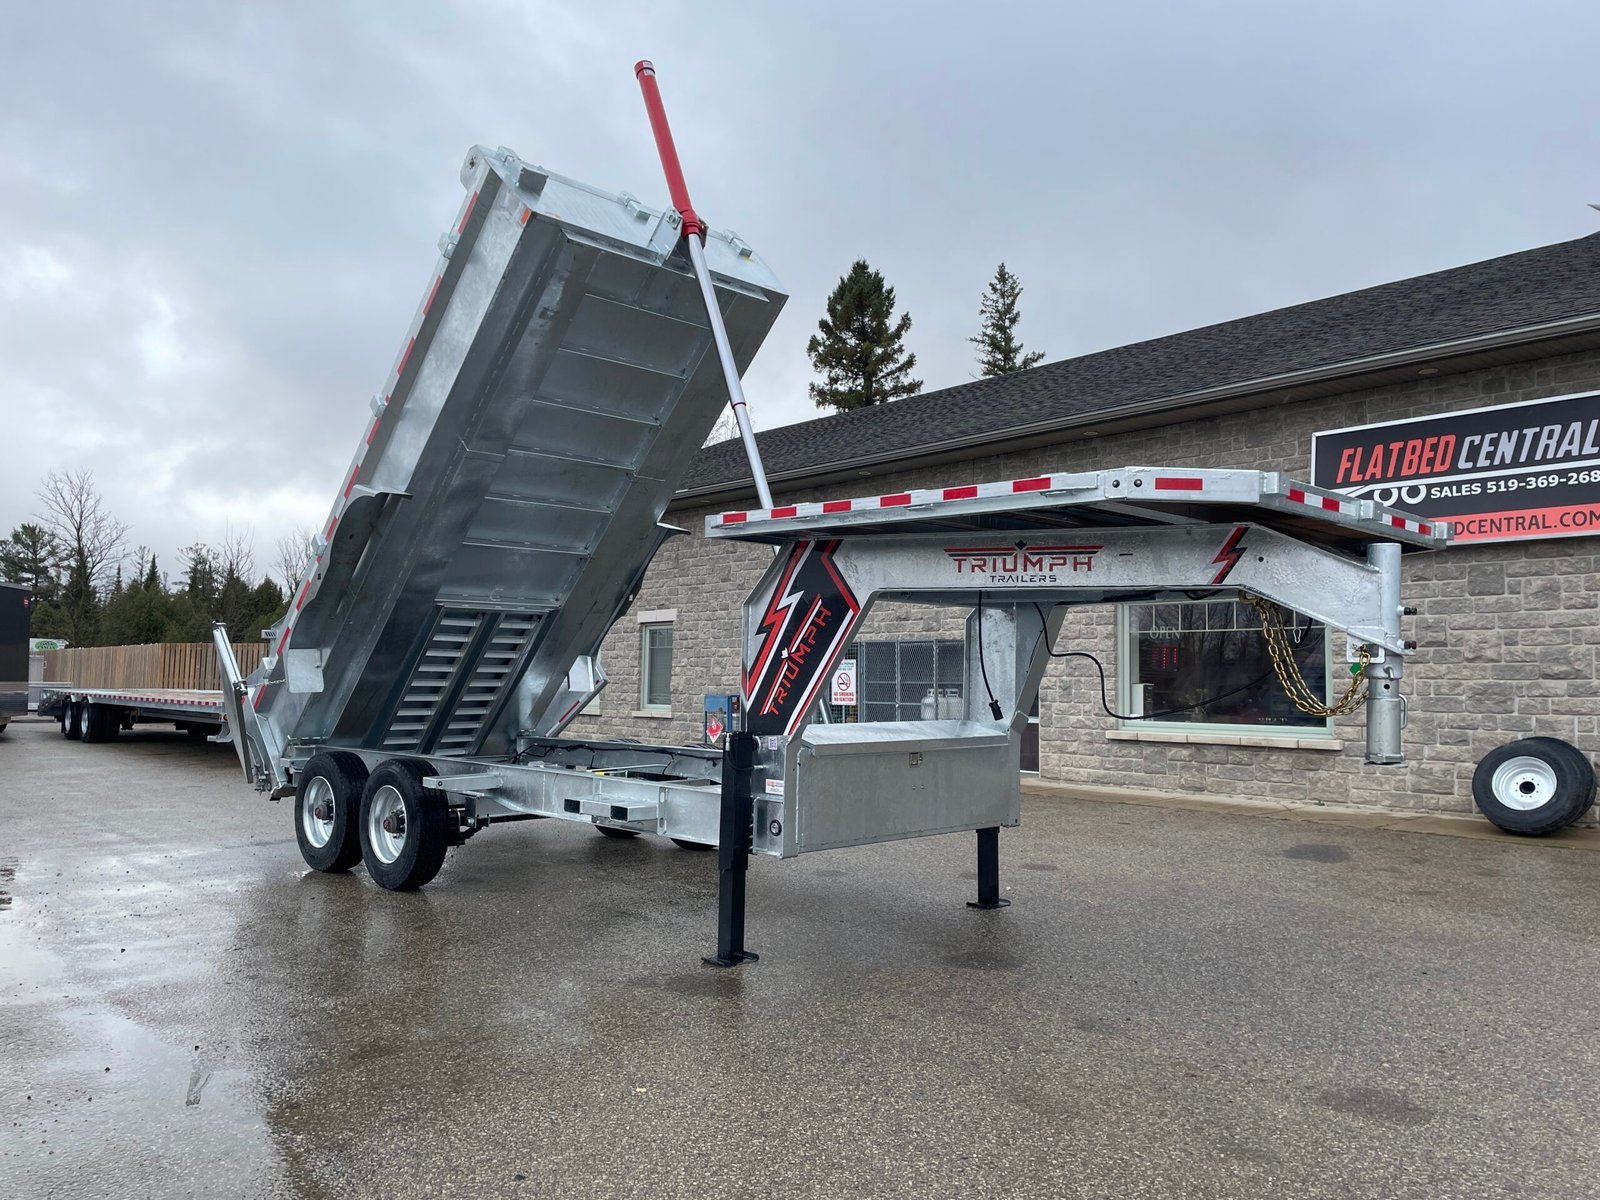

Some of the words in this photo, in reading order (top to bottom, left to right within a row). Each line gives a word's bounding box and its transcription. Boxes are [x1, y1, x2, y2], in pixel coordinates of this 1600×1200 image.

[1336, 434, 1457, 484] FLATBED
[1457, 418, 1600, 469] CENTRAL
[1430, 482, 1482, 499] SALES
[952, 554, 1093, 573] TRIUMPH
[990, 574, 1057, 583] TRAILERS
[1150, 625, 1180, 639] OPEN
[768, 605, 832, 715] TRIUMPH
